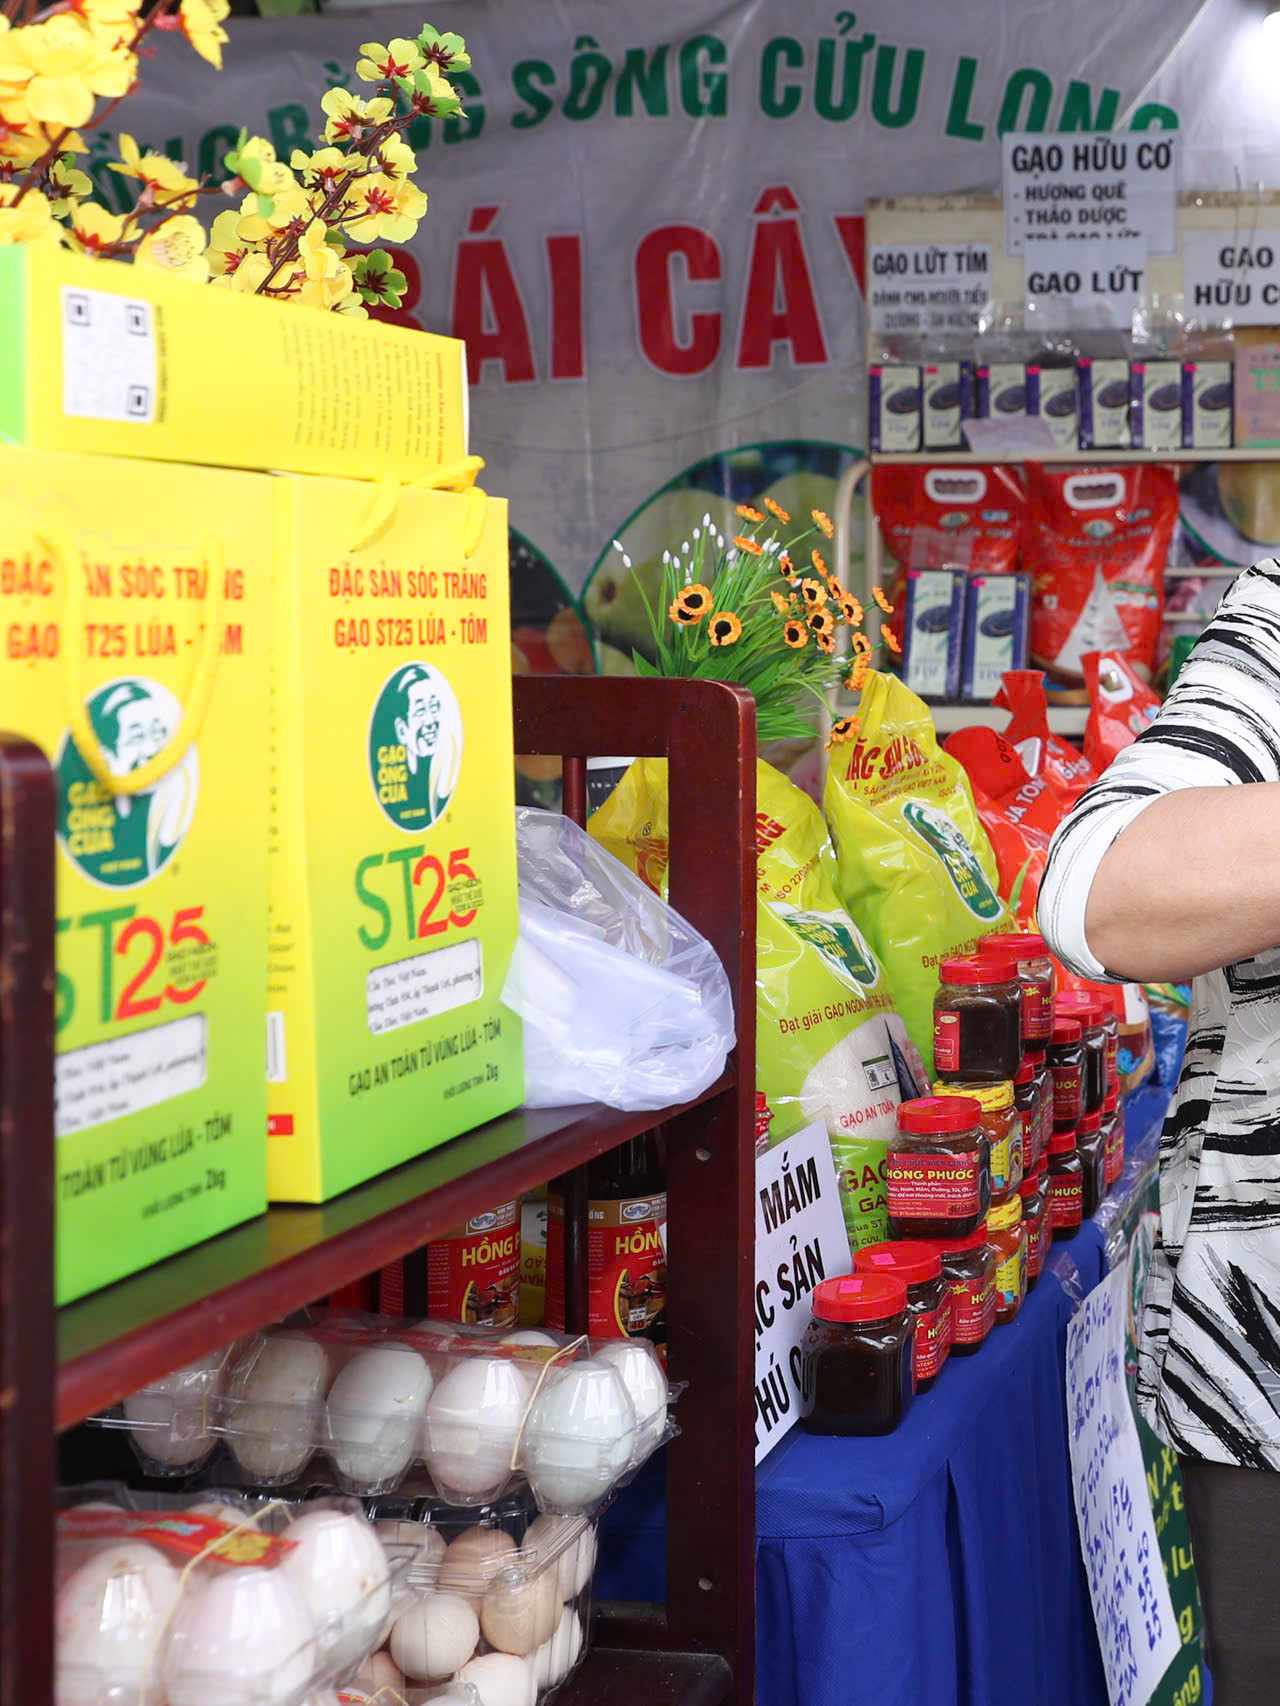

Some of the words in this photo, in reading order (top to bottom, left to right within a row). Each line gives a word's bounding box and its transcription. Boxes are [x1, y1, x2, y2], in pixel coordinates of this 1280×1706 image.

[511, 34, 728, 130] SÔNG
[758, 10, 925, 129] CỬU
[1011, 145, 1063, 179] GẠO
[1073, 136, 1127, 172] HỮU
[1136, 138, 1173, 171] CƠ
[873, 252, 908, 281] GẠO
[914, 246, 948, 275] LỨT
[954, 244, 988, 274] TÍM
[1219, 246, 1275, 273] GẠO
[1028, 270, 1082, 298] GẠO
[1092, 265, 1144, 294] LỨT
[1194, 277, 1251, 306] HỮU
[120, 557, 166, 599] SÓC
[328, 562, 365, 604] ĐẶC
[370, 559, 403, 598] SẢN
[407, 564, 439, 599] SÓC
[443, 567, 488, 600] TRĂNG
[7, 622, 61, 669] GẠO
[85, 623, 127, 658] T25
[134, 615, 178, 658] LÚA
[334, 618, 371, 655] GẠO
[375, 618, 414, 647] ST25
[418, 611, 447, 645] LÚA
[459, 611, 488, 645] TÔM
[377, 744, 407, 764] GẠO
[377, 764, 409, 785] ÔNG
[379, 783, 409, 804] CUA
[355, 845, 478, 951] ST25
[779, 1018, 800, 1034] Đạt
[802, 1008, 823, 1031] giải
[824, 1001, 845, 1022] GẠO
[349, 1068, 371, 1097] GẠO
[374, 1063, 389, 1086] AN
[391, 1048, 418, 1078] TOÀN
[433, 1034, 459, 1062] VÙNG
[460, 1024, 477, 1053] LÚA
[483, 1016, 501, 1043] TÔM
[485, 1063, 498, 1082] 2kg
[839, 1110, 864, 1129] GẠO
[866, 1106, 877, 1120] AN
[878, 1099, 896, 1118] TOÀN
[928, 1168, 975, 1180] PHƯỚC
[759, 1149, 822, 1236] MẮM
[462, 1236, 513, 1268] HỒNG
[777, 1235, 826, 1310] SẢN
